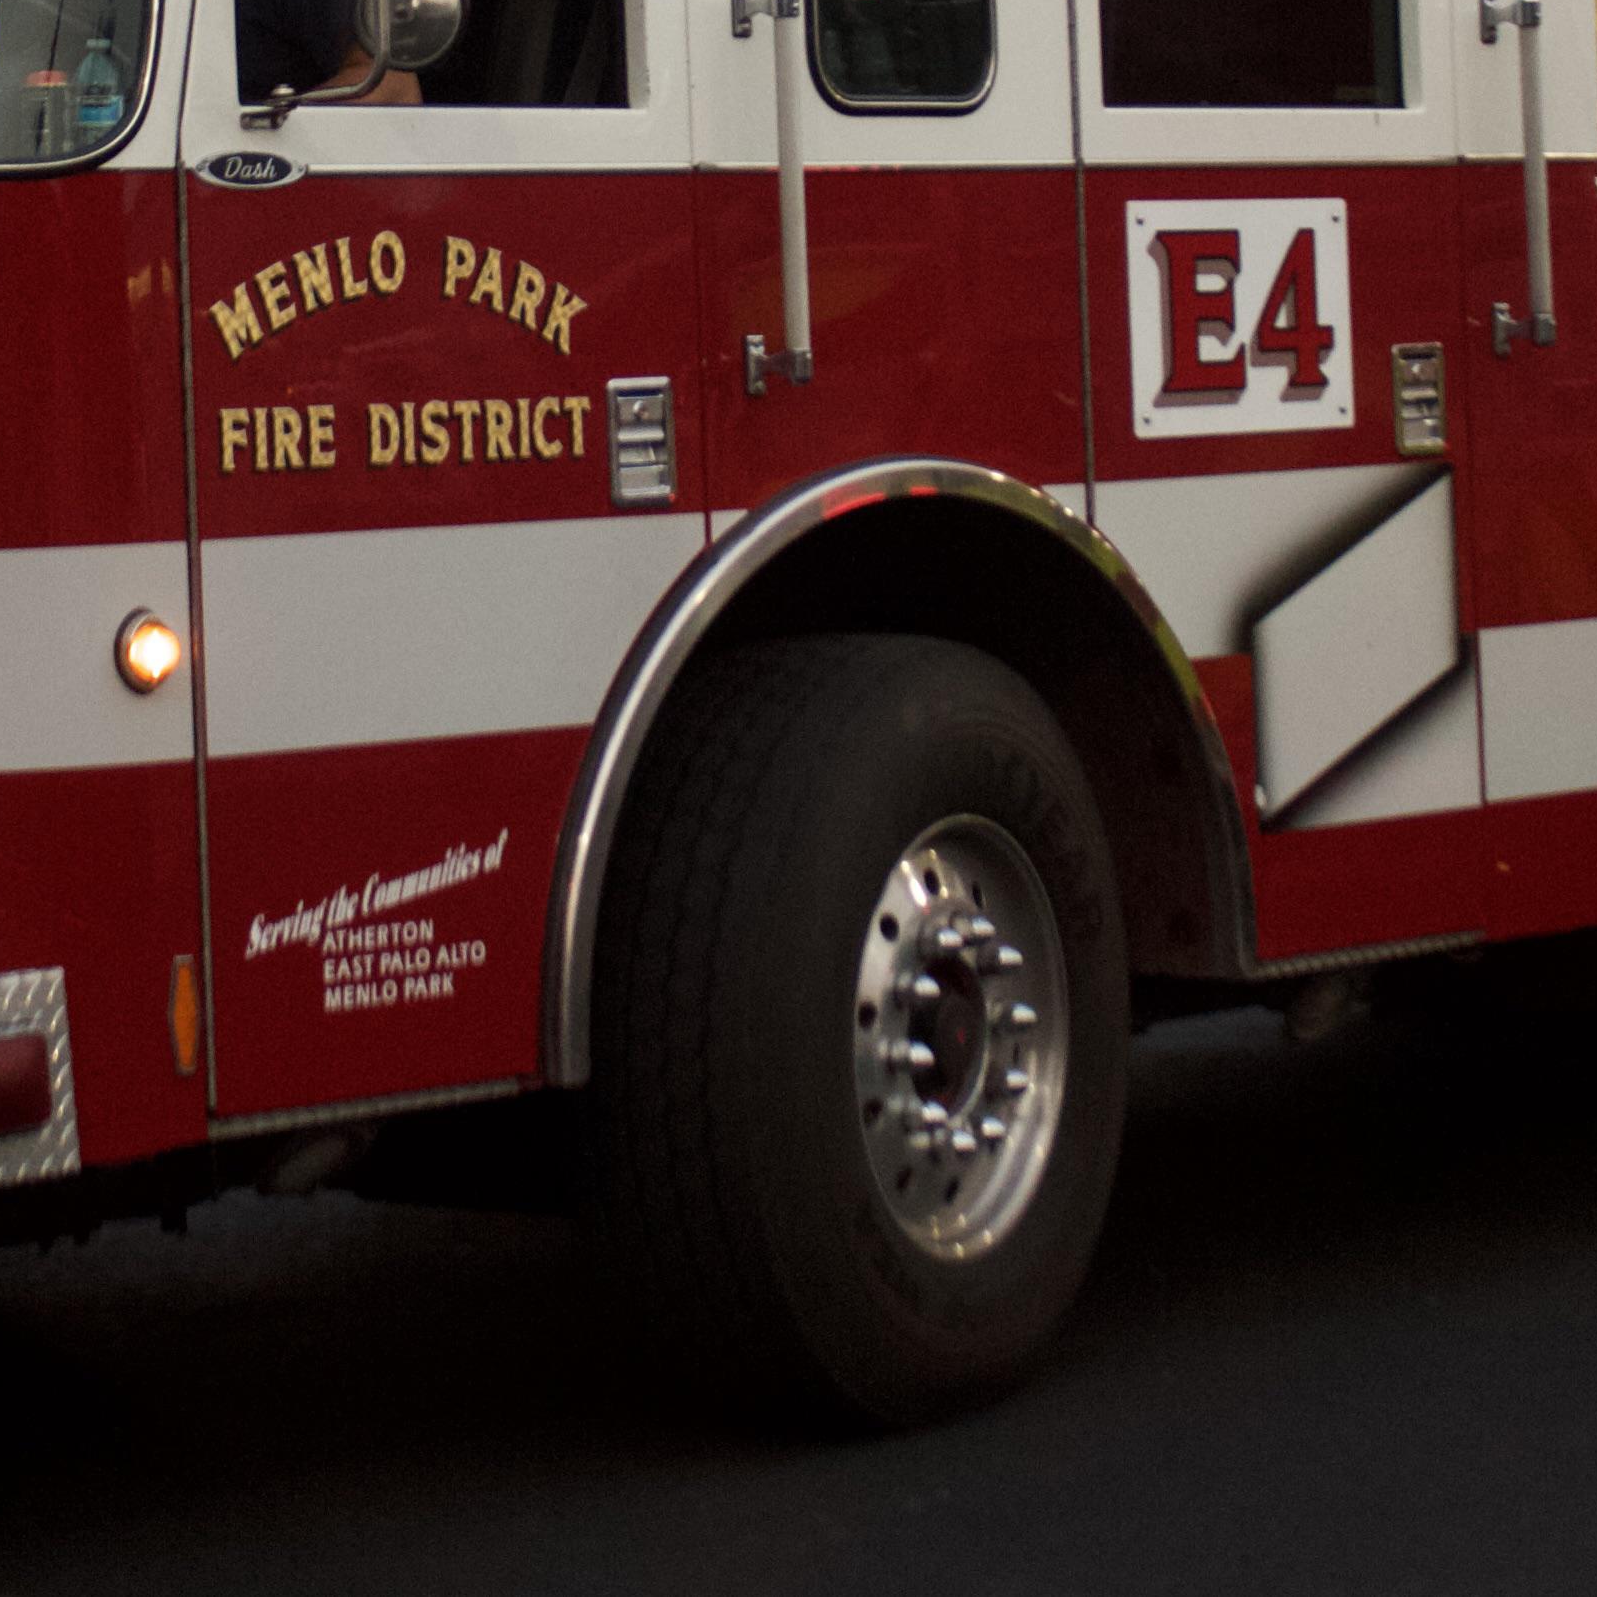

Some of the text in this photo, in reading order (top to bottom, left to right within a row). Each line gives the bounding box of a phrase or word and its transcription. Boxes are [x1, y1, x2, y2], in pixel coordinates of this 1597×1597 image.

[223, 155, 279, 181] Dash
[208, 230, 590, 361] MENLO PARK
[1147, 227, 1335, 408] E4
[219, 396, 591, 473] FIRE DISTRICT
[244, 826, 510, 961] Serving the Communities of
[322, 918, 435, 953] ATHERTON
[323, 938, 487, 984] EAST PALO ALTO
[323, 971, 455, 1014] MENLO PARK
